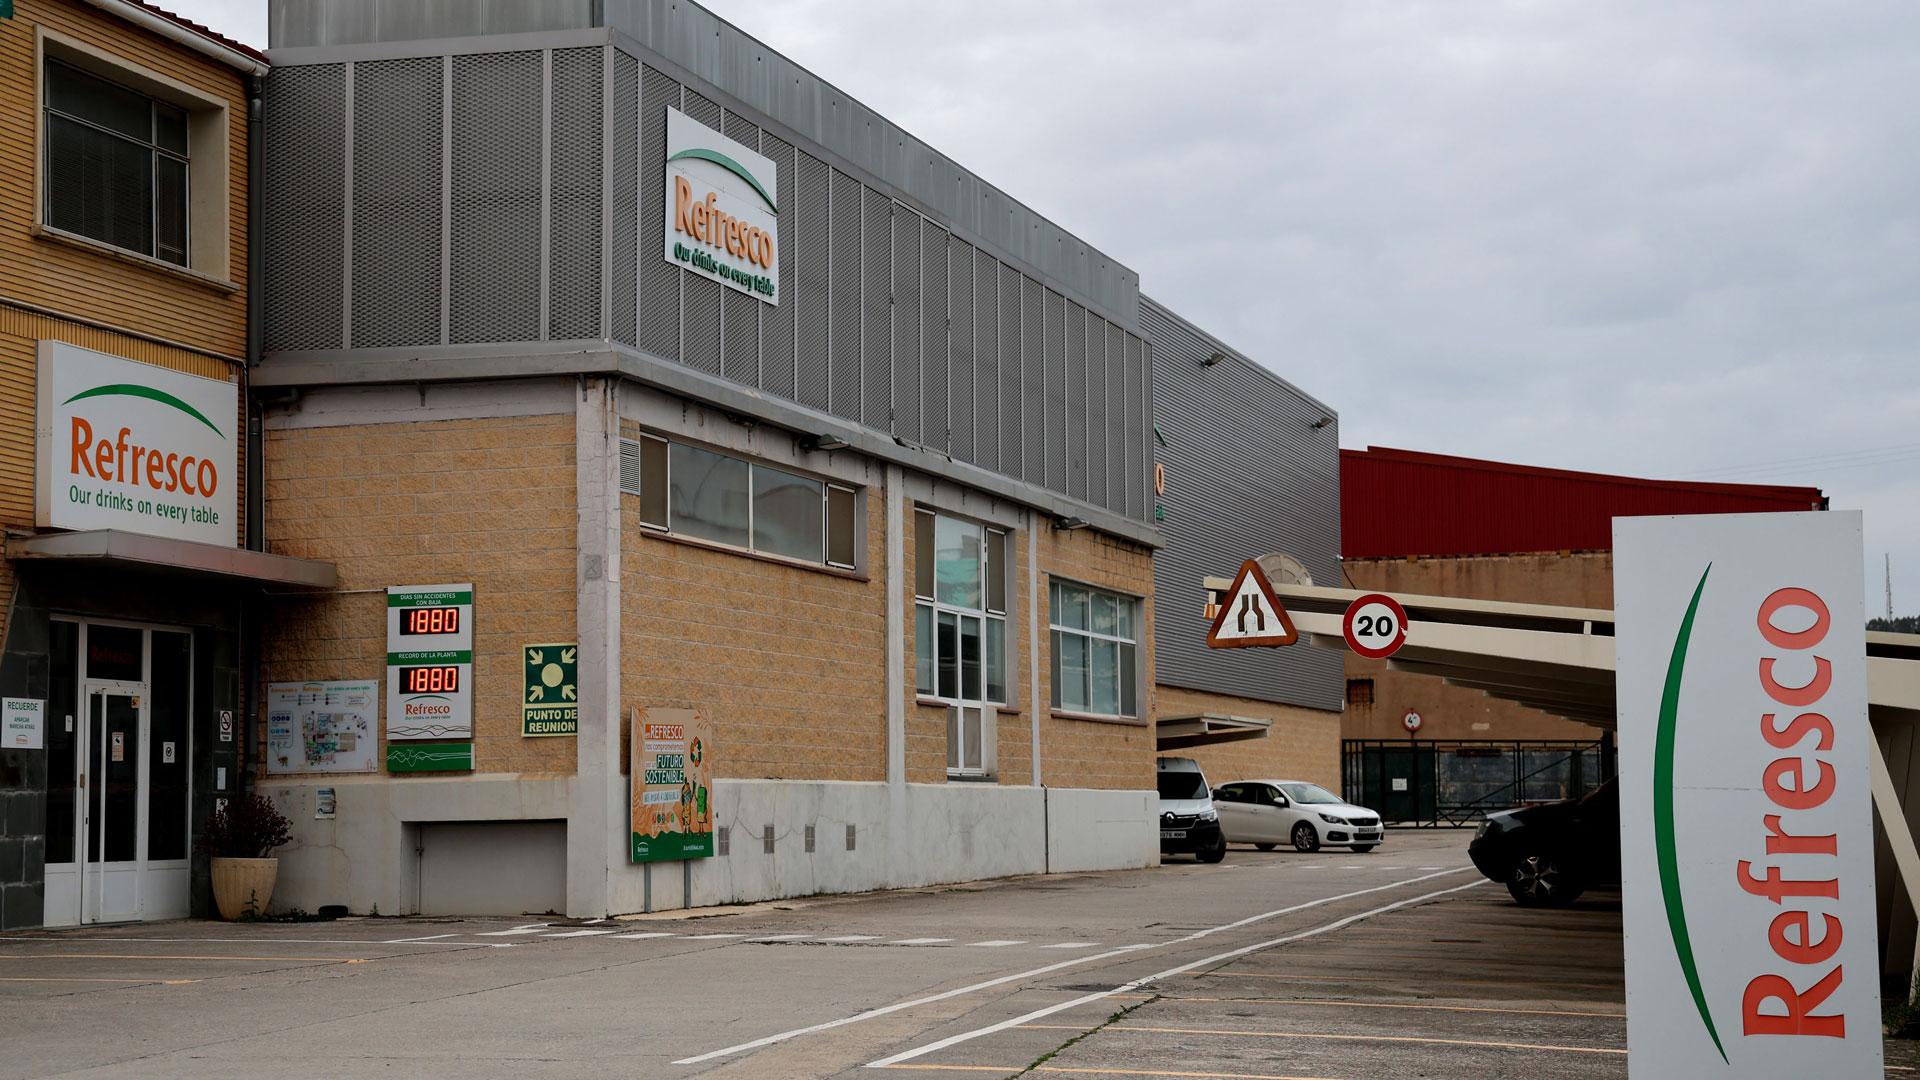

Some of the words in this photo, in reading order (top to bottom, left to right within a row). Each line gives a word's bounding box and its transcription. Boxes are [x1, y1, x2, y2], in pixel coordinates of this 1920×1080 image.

[675, 175, 773, 270] Refresco
[674, 241, 690, 262] Our
[691, 248, 718, 274] drinks
[718, 263, 731, 279] on
[731, 268, 753, 292] every
[753, 275, 775, 297] table
[70, 416, 218, 498] Refresco
[69, 485, 92, 505] Our
[95, 488, 133, 512] drinks
[137, 499, 152, 515] on
[156, 502, 188, 525] every
[191, 506, 219, 525] table
[424, 592, 456, 600] ACCIDENTES
[410, 608, 457, 632] 1880
[1357, 615, 1393, 637] 20
[410, 668, 457, 691] 1880
[7, 701, 38, 711] RECUERDE
[405, 703, 450, 715] Refresco
[526, 709, 562, 721] PUNTO
[564, 709, 578, 720] DE
[528, 721, 576, 733] REUNION
[650, 725, 684, 739] REFRESCO
[657, 754, 684, 768] FUTURO
[645, 770, 684, 784] SOSTENIBLE
[1736, 586, 1846, 1040] Refresco
